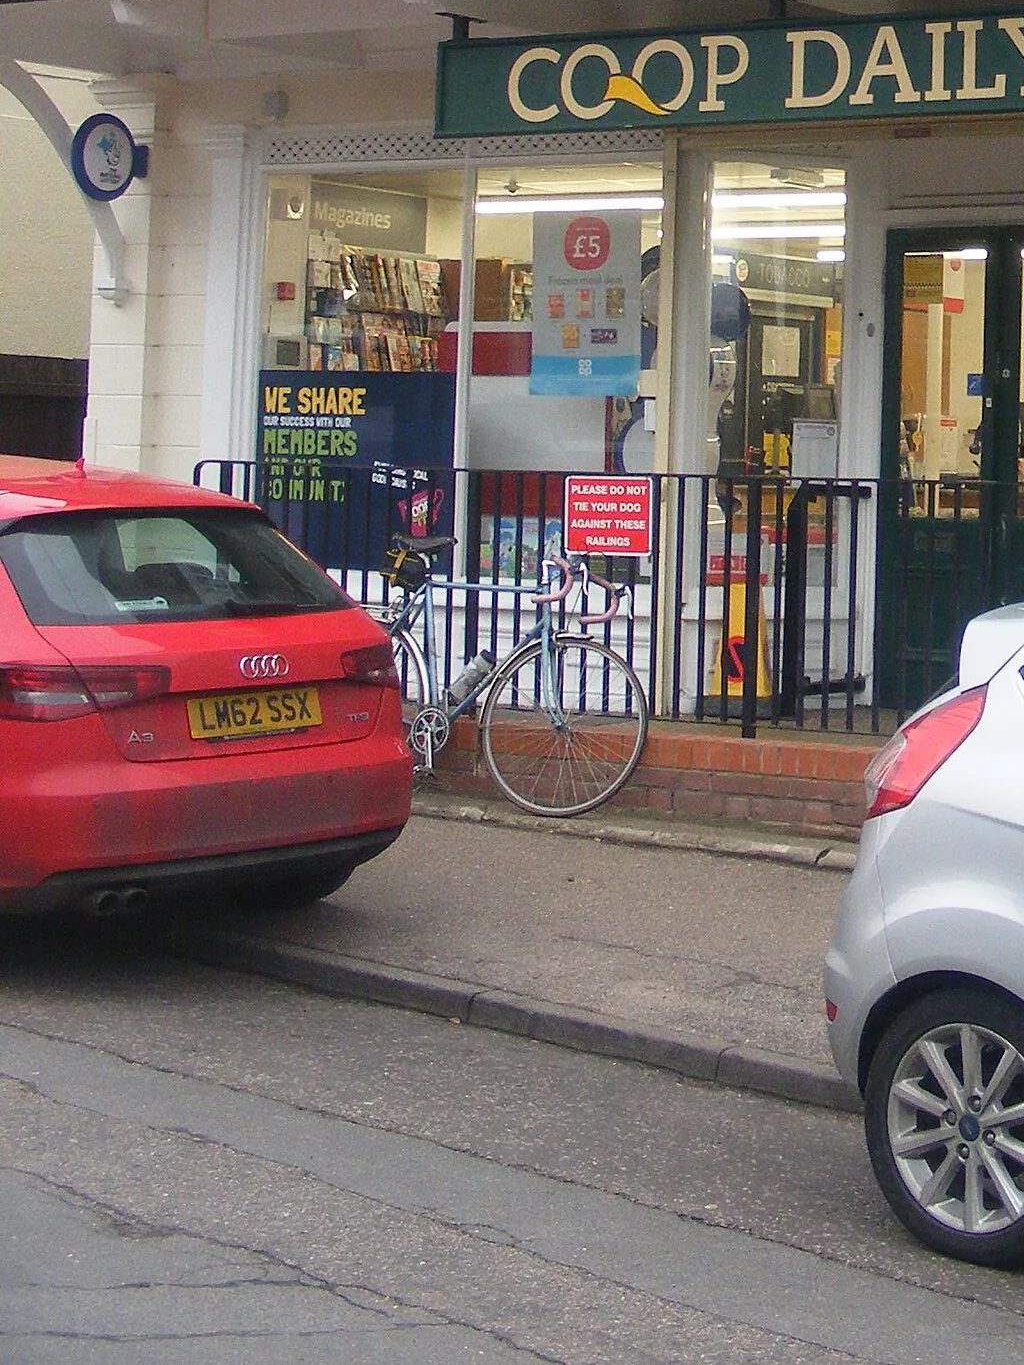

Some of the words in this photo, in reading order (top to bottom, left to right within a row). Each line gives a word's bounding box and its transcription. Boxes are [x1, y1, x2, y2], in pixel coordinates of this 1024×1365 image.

[314, 200, 392, 230] Magazines
[572, 234, 601, 259] £5
[264, 386, 292, 414] WE
[297, 387, 367, 416] SHARE
[263, 415, 279, 426] OUR
[280, 416, 315, 427] SUCCESS
[316, 417, 333, 427] WITH
[335, 417, 352, 428] OUR
[263, 428, 358, 457] MEMBERS
[571, 484, 608, 495] PLEASE
[609, 485, 625, 495] DO
[626, 486, 647, 496] NOT
[573, 501, 589, 512] TIE
[591, 502, 618, 512] YOUR
[619, 502, 642, 513] DOG
[570, 518, 613, 529] AGAINST
[614, 519, 646, 530] THESE
[585, 535, 631, 547] RAILINGS
[199, 697, 263, 731] LM62
[266, 691, 313, 723] SSX
[127, 729, 154, 744] A3
